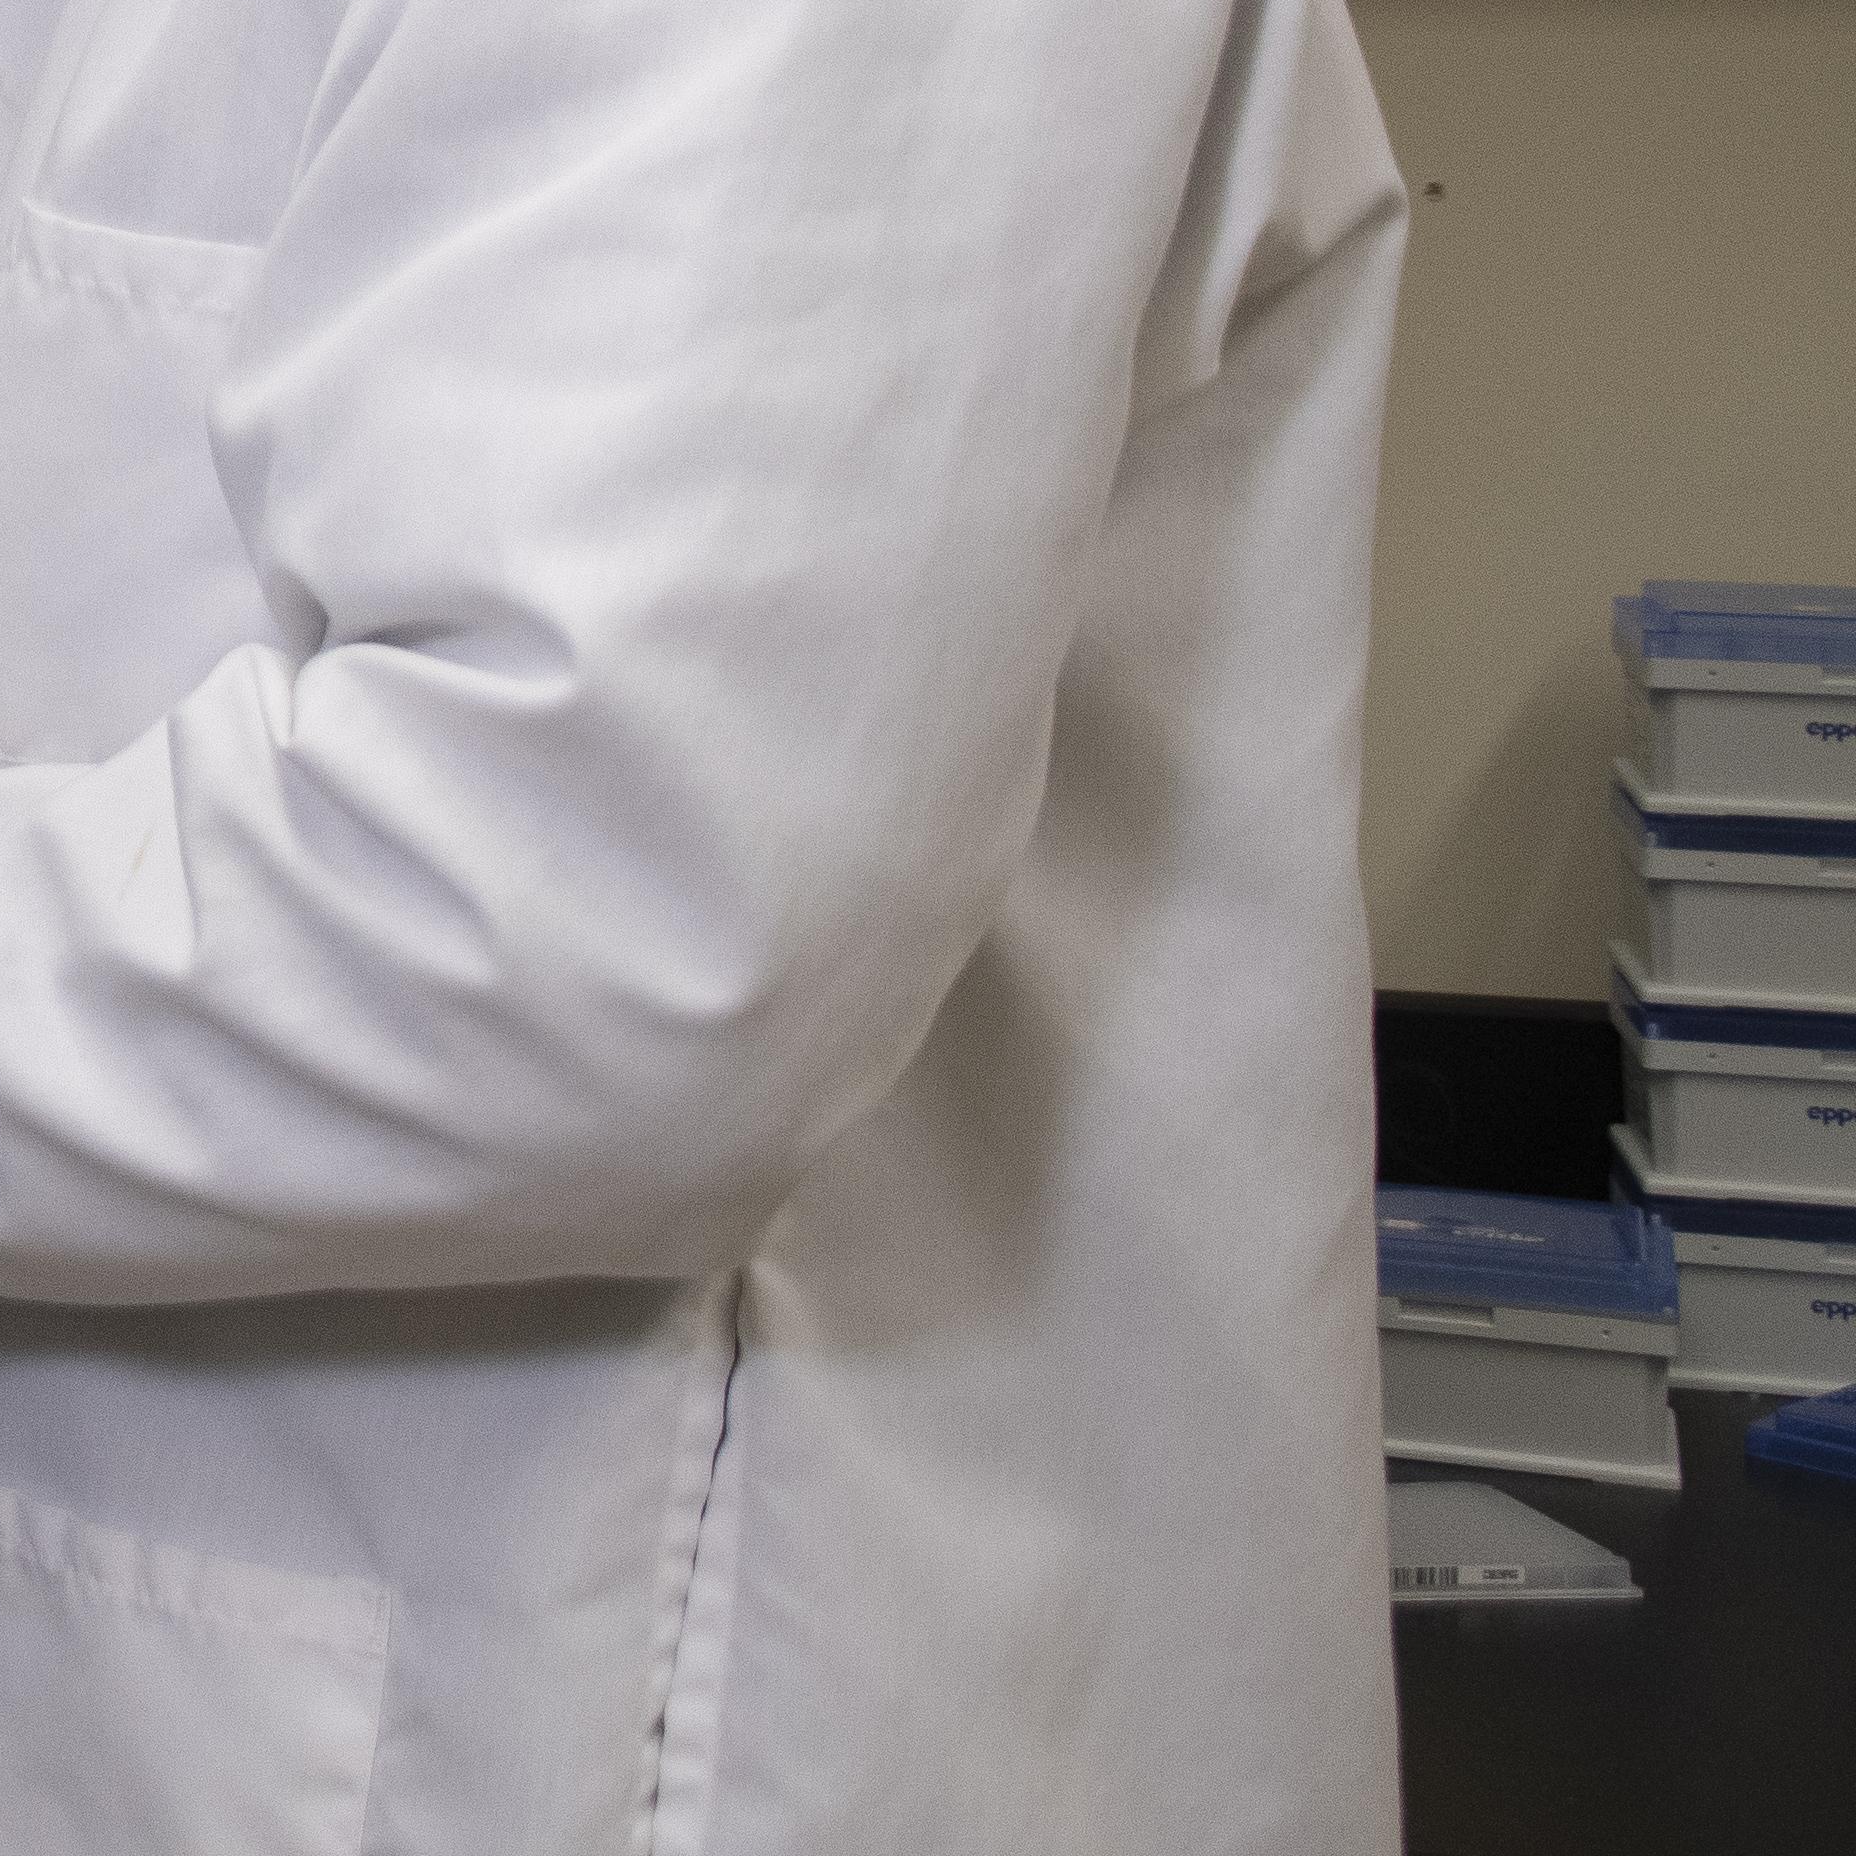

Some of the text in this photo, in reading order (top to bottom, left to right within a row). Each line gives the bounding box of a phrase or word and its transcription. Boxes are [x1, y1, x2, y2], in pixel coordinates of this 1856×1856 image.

[1805, 721, 1856, 742] epp
[1807, 1105, 1856, 1127] epp
[1810, 1299, 1856, 1321] epp
